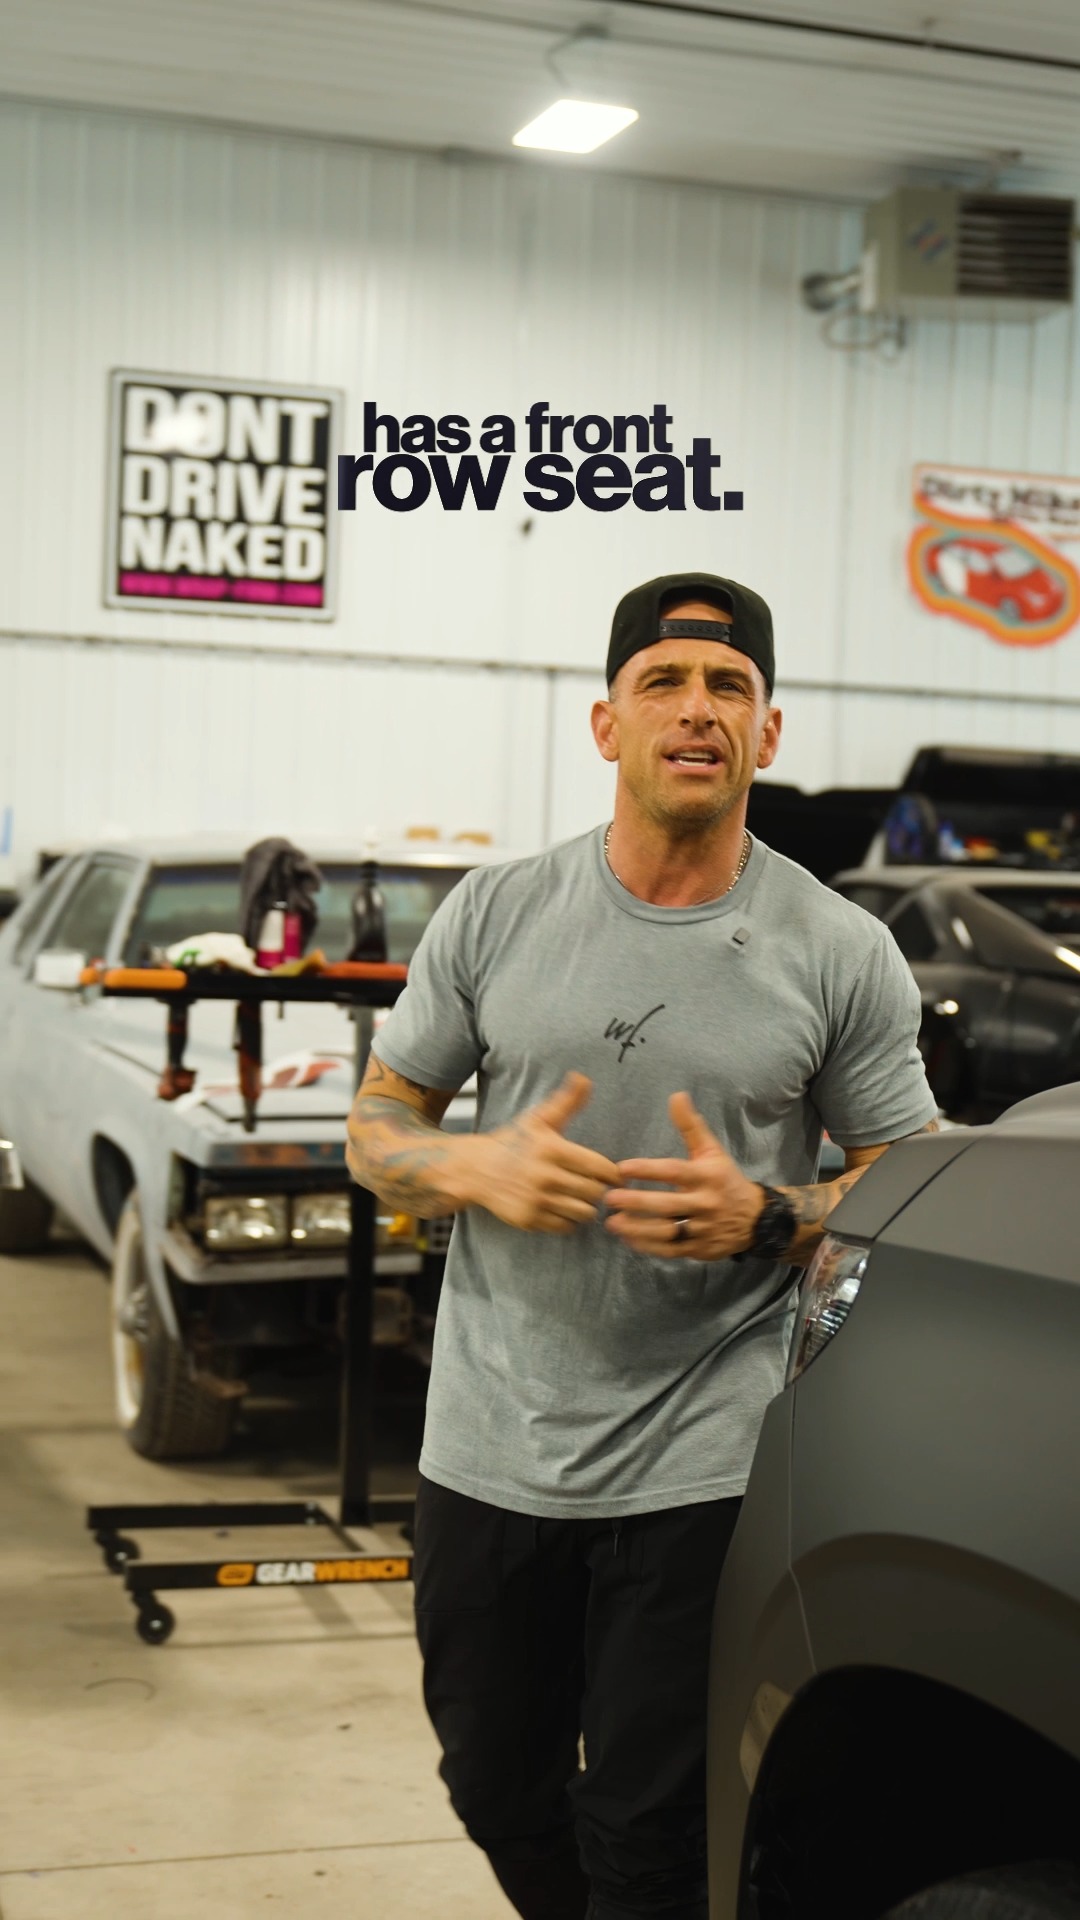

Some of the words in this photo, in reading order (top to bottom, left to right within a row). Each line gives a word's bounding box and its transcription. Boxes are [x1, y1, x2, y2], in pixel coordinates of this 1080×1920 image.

[125, 385, 330, 466] DONT
[121, 455, 327, 528] DRIVE
[119, 514, 325, 582] NAKED
[255, 1558, 410, 1584] GEARWRENCH
